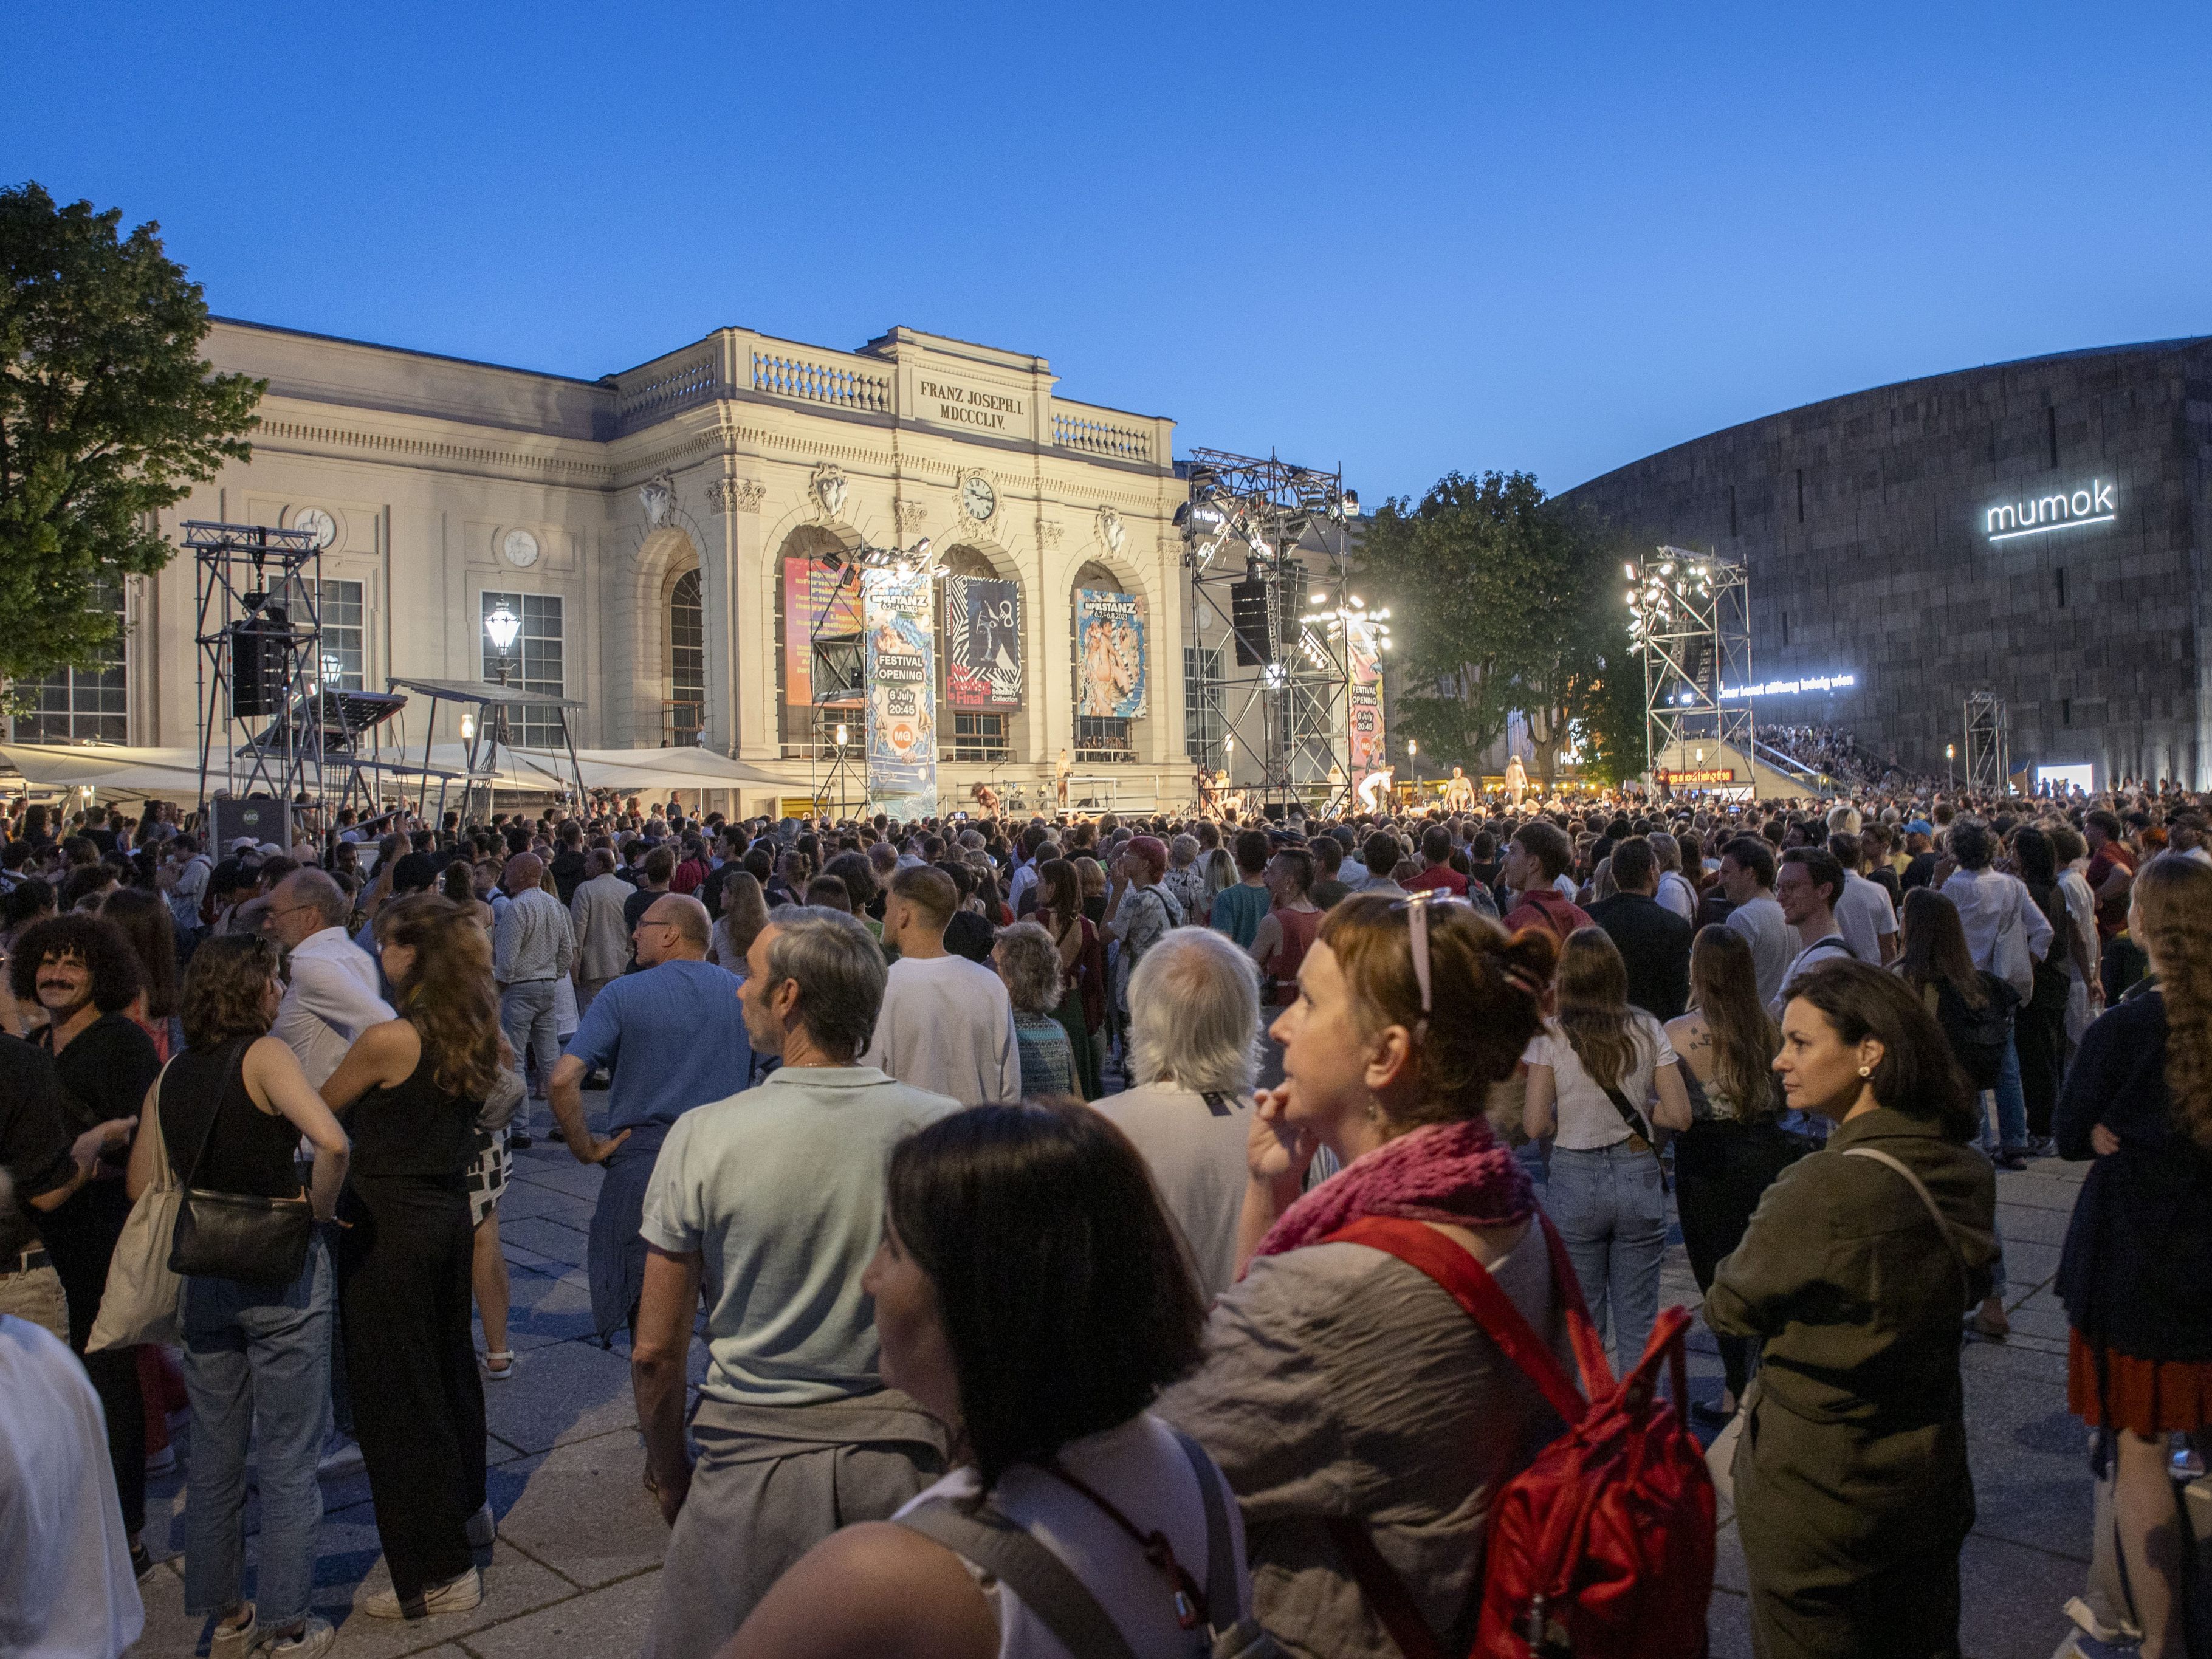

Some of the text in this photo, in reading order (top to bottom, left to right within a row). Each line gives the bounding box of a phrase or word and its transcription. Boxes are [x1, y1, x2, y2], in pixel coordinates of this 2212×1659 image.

[920, 380, 964, 403] FRANZ
[940, 404, 1006, 430] MDCCCLIV.
[1987, 479, 2114, 532] mumok
[1085, 602, 1136, 614] IMPULSTANZ
[879, 654, 923, 667] FESTIVAL
[879, 669, 923, 681] OPENING
[951, 663, 970, 677] No
[947, 676, 992, 695] Feeling
[1352, 685, 1376, 695] FESTIVAL
[889, 690, 915, 702] 6 July
[956, 690, 984, 705] Final
[992, 688, 1017, 697] Solidarity
[1352, 696, 1377, 706] OPENING
[889, 704, 915, 715] 20:45
[1362, 712, 1373, 722] July
